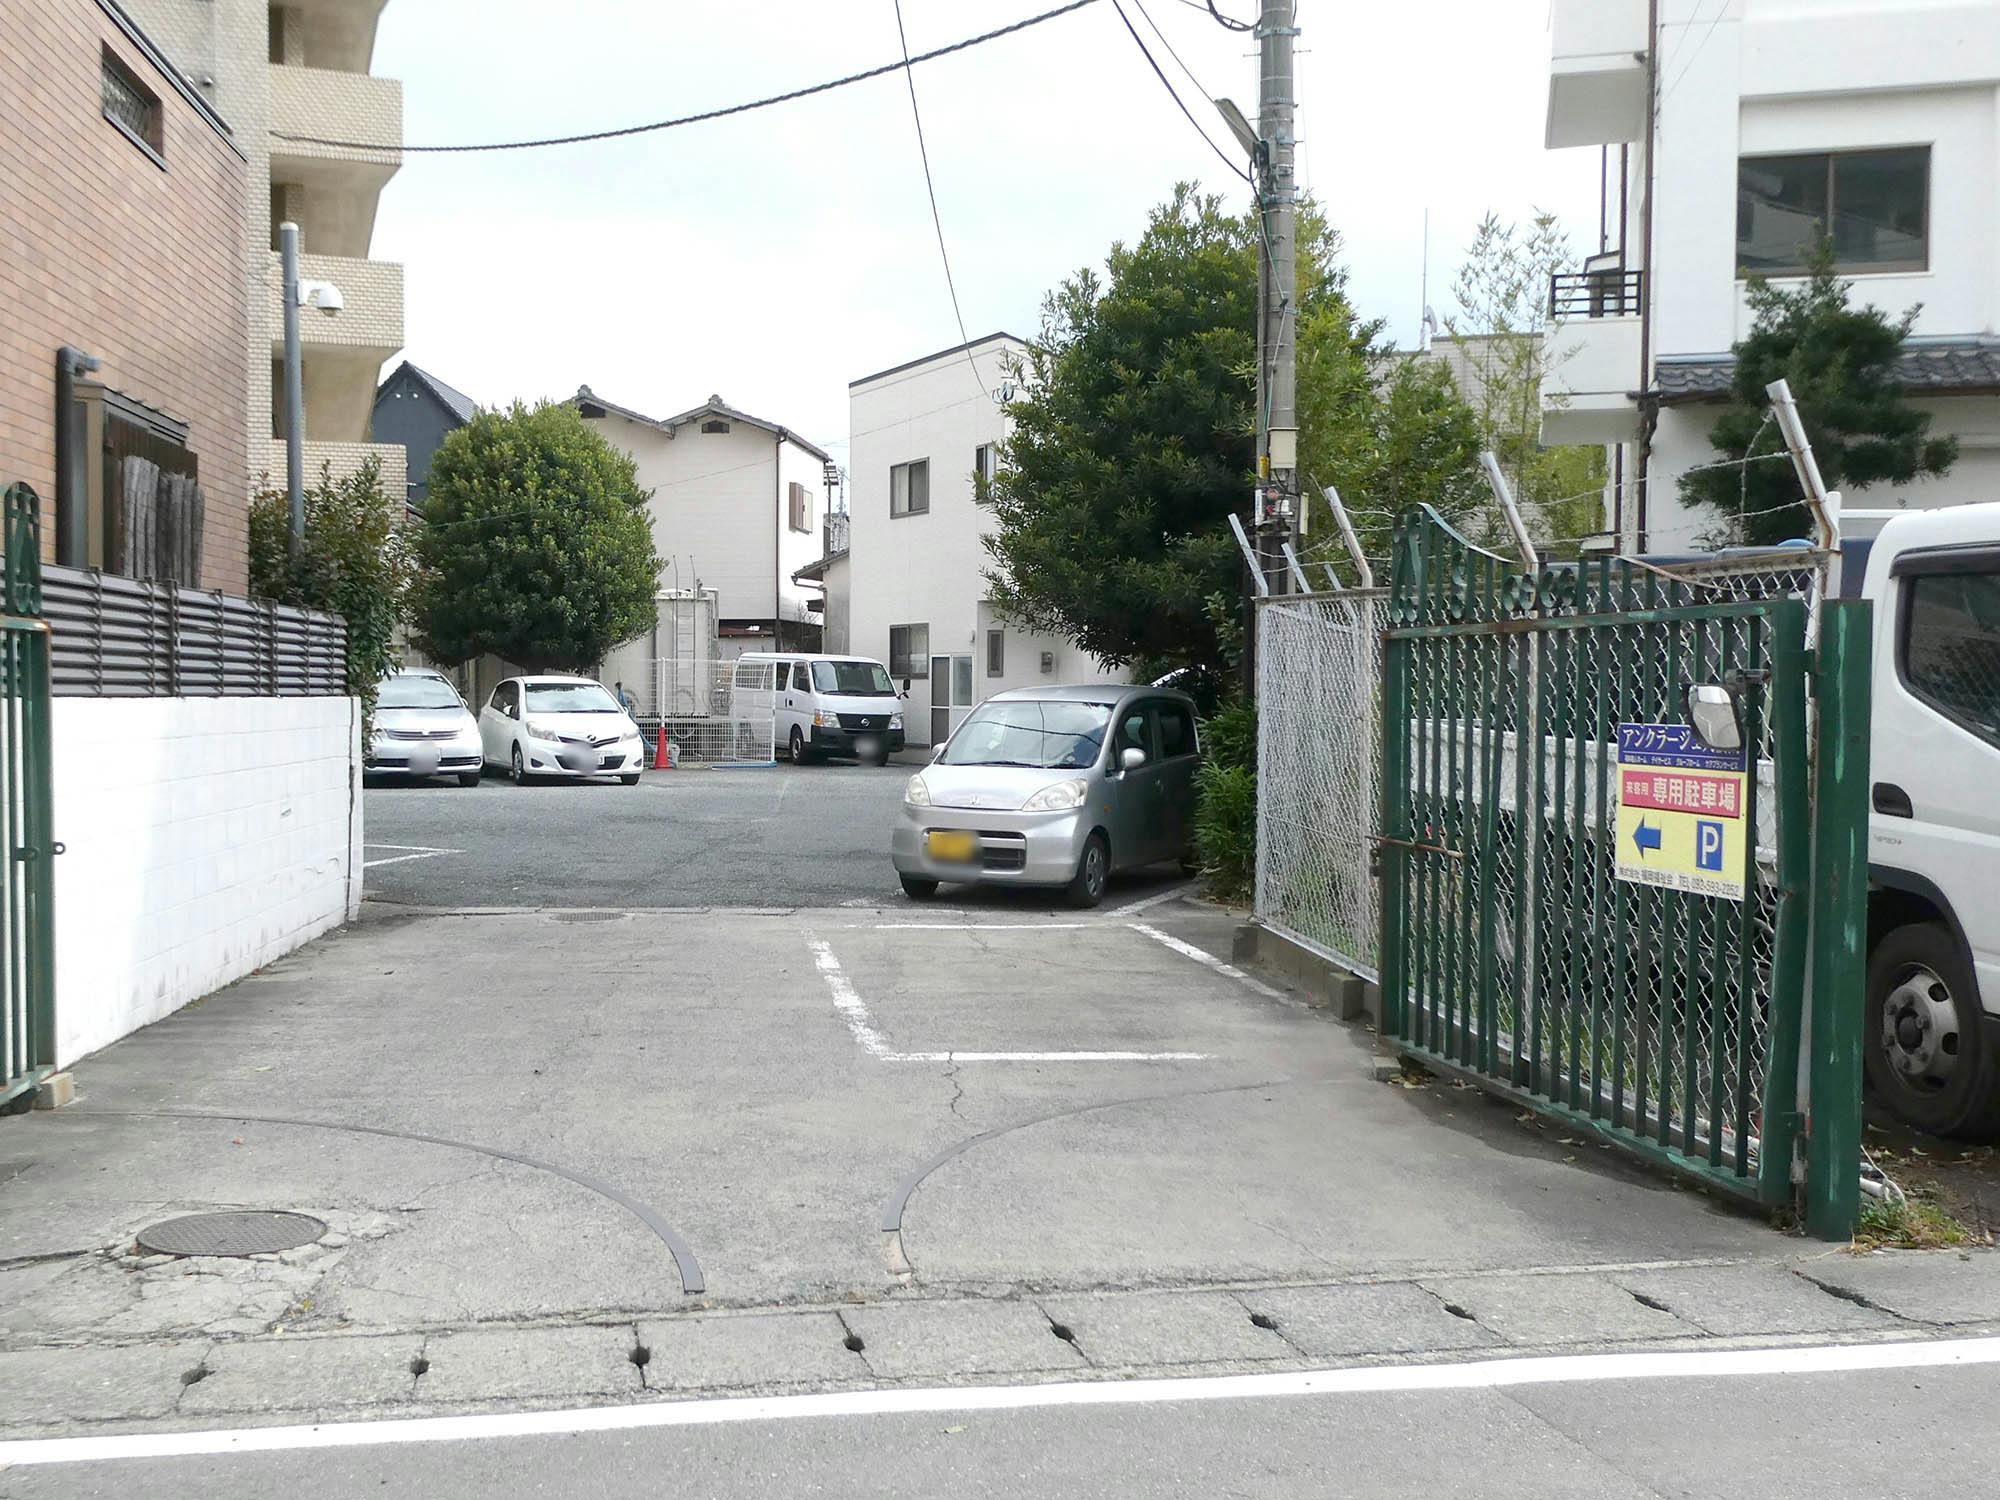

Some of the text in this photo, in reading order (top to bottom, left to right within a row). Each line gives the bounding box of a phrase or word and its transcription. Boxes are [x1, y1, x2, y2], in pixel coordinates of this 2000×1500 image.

[1623, 727, 1740, 754] アンクラージュ
[1625, 777, 1735, 811] 来客用 専用駐車場
[1702, 825, 1719, 865] P
